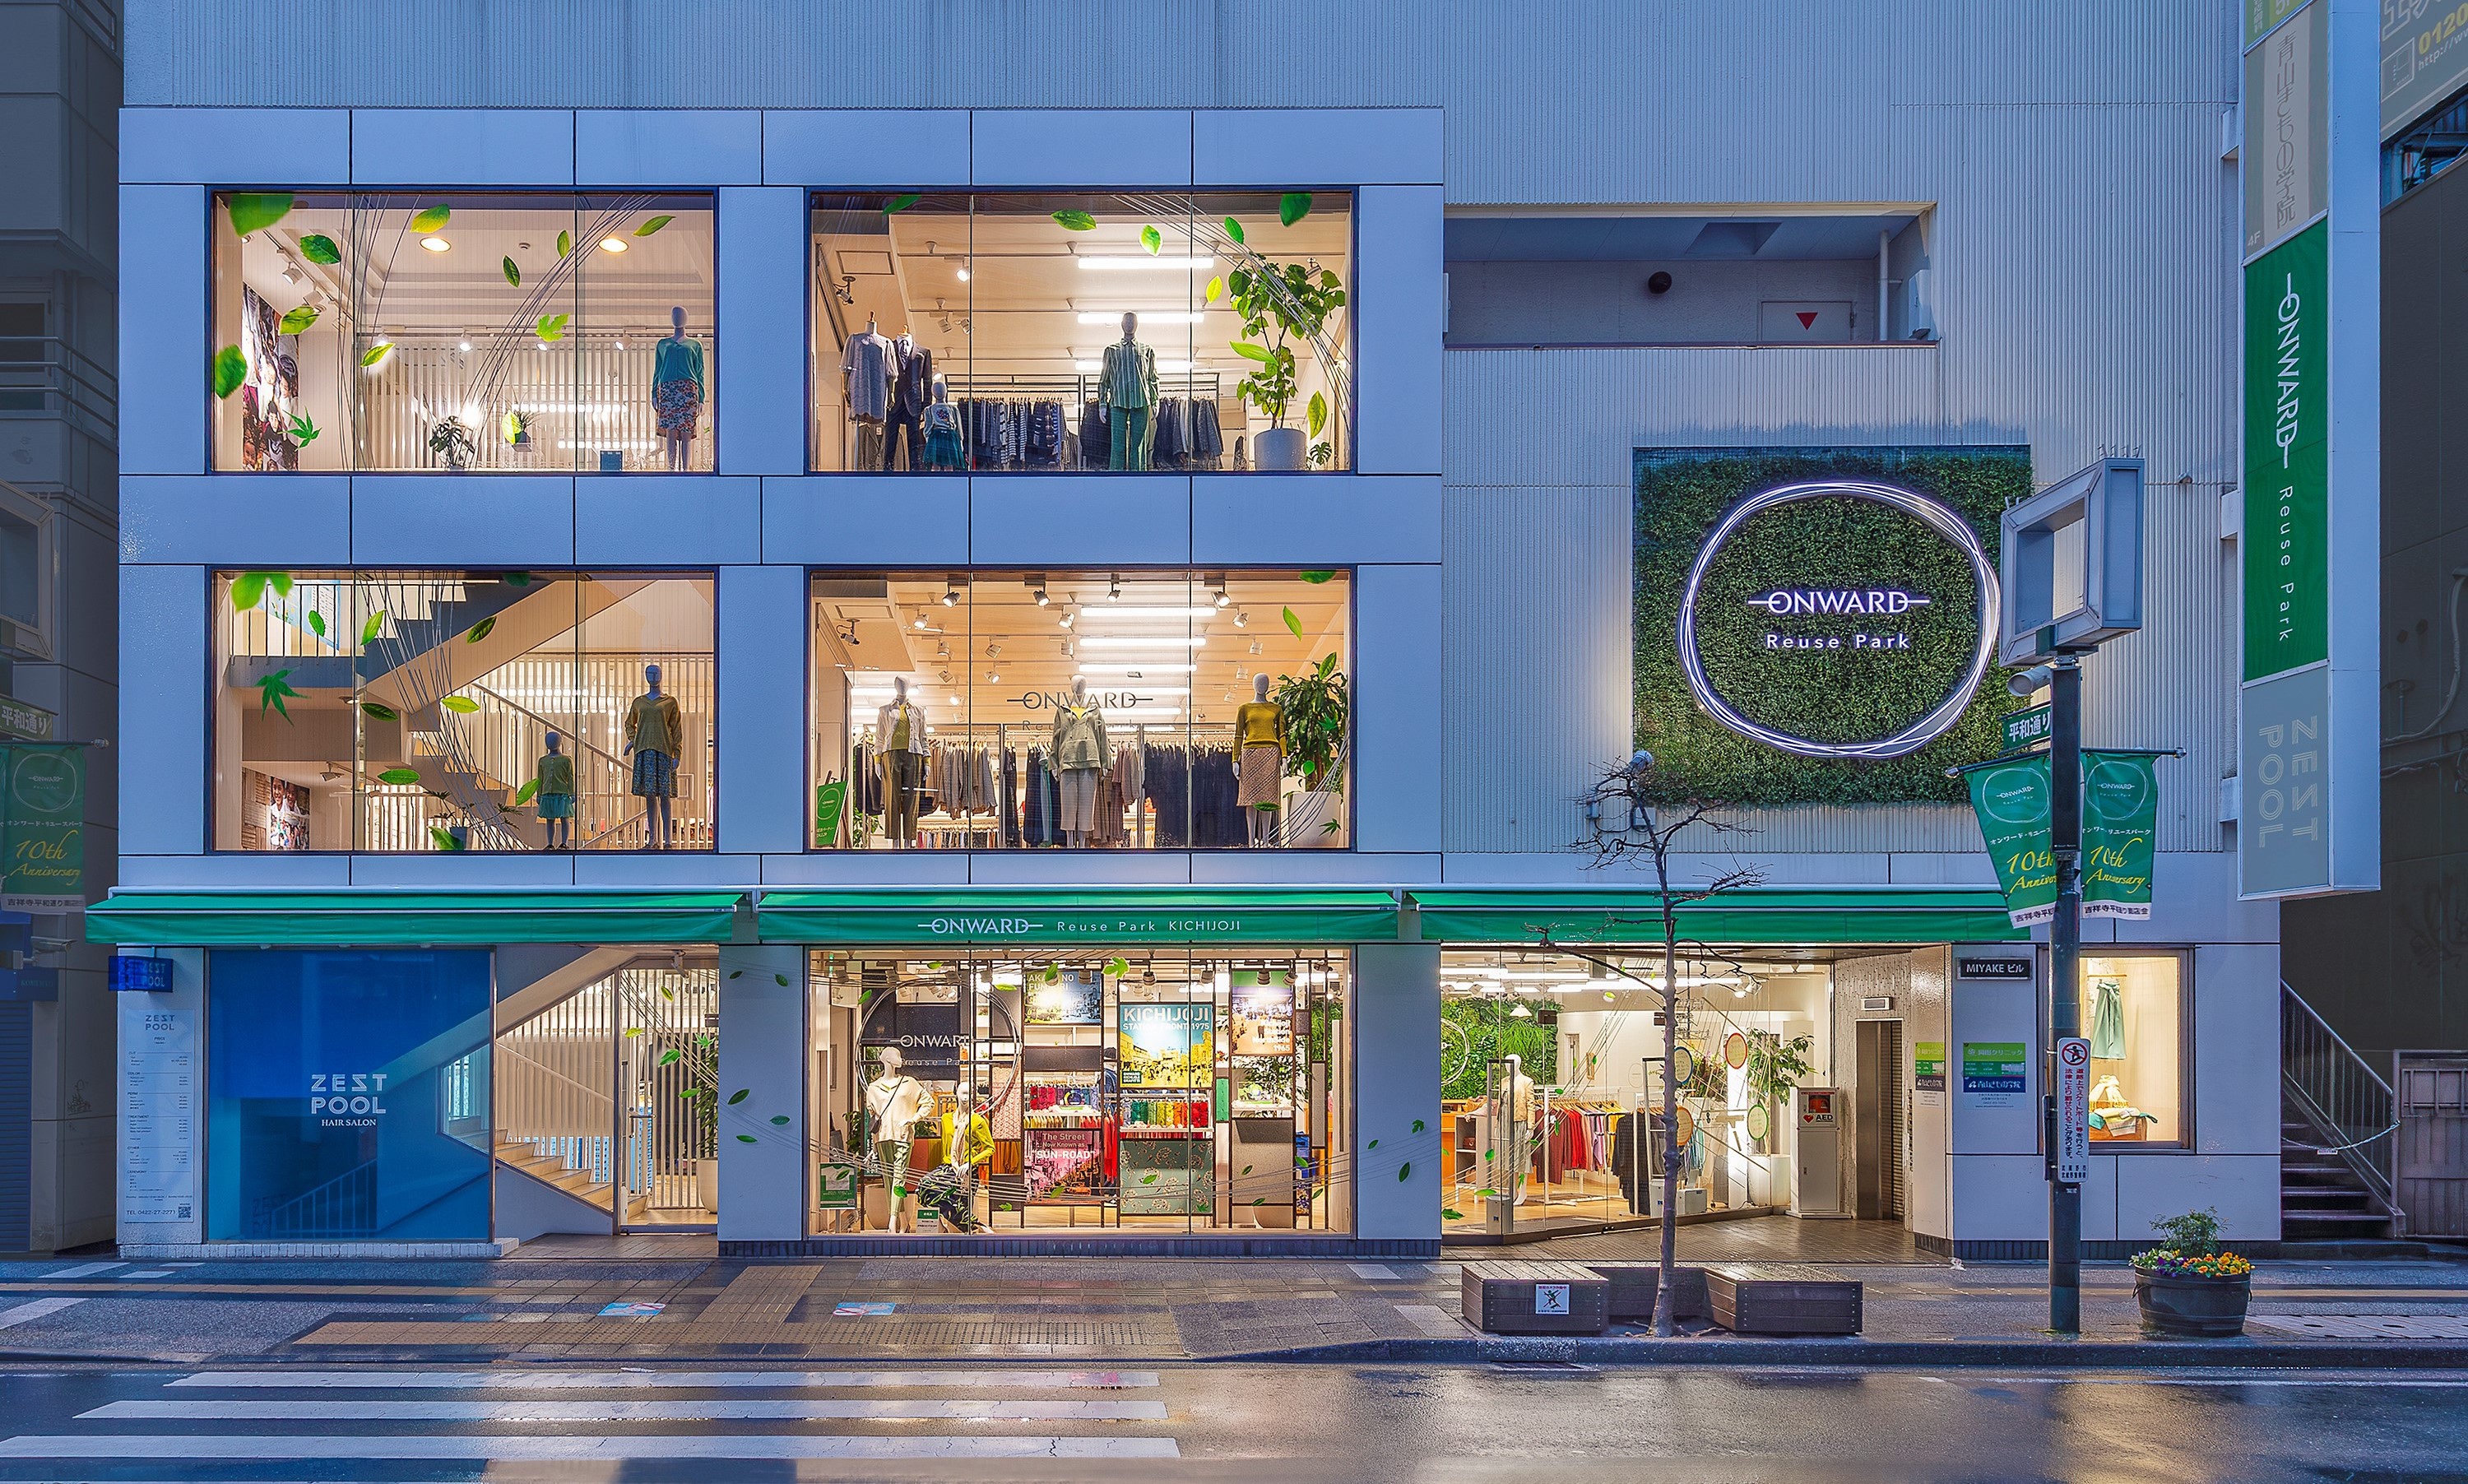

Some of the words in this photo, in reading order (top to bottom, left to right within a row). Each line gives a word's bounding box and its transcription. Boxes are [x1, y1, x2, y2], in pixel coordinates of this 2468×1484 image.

[2419, 2, 2468, 54] 0120
[2275, 30, 2297, 230] 青山きもの学院
[2248, 230, 2261, 247] 4F
[2275, 272, 2300, 469] ONWARD
[2279, 485, 2294, 567] Reuse
[1747, 591, 1930, 614] ONWARD
[2279, 582, 2294, 642] Park
[1766, 634, 1839, 648] Reuse
[1855, 633, 1910, 648] Park
[1006, 691, 1153, 709] ONWARD
[2, 705, 47, 735] 平和通り
[2008, 713, 2051, 742] 平和通り
[1996, 786, 2034, 798] ONWARD
[2258, 724, 2285, 848] POOL
[16, 829, 79, 860] 10th
[7, 898, 84, 907] 吉祥寺平和通り
[917, 917, 1044, 934] ONWARD
[1057, 921, 1107, 931] Reuse
[1119, 921, 1156, 931] Park
[1168, 920, 1241, 931] KICHIJOJI
[1966, 963, 2005, 973] MIYAKE
[2007, 963, 2025, 973] ビル
[1124, 1008, 1208, 1022] KICHIJOJI
[311, 1074, 387, 1092] ZEST
[311, 1097, 387, 1114] POOL
